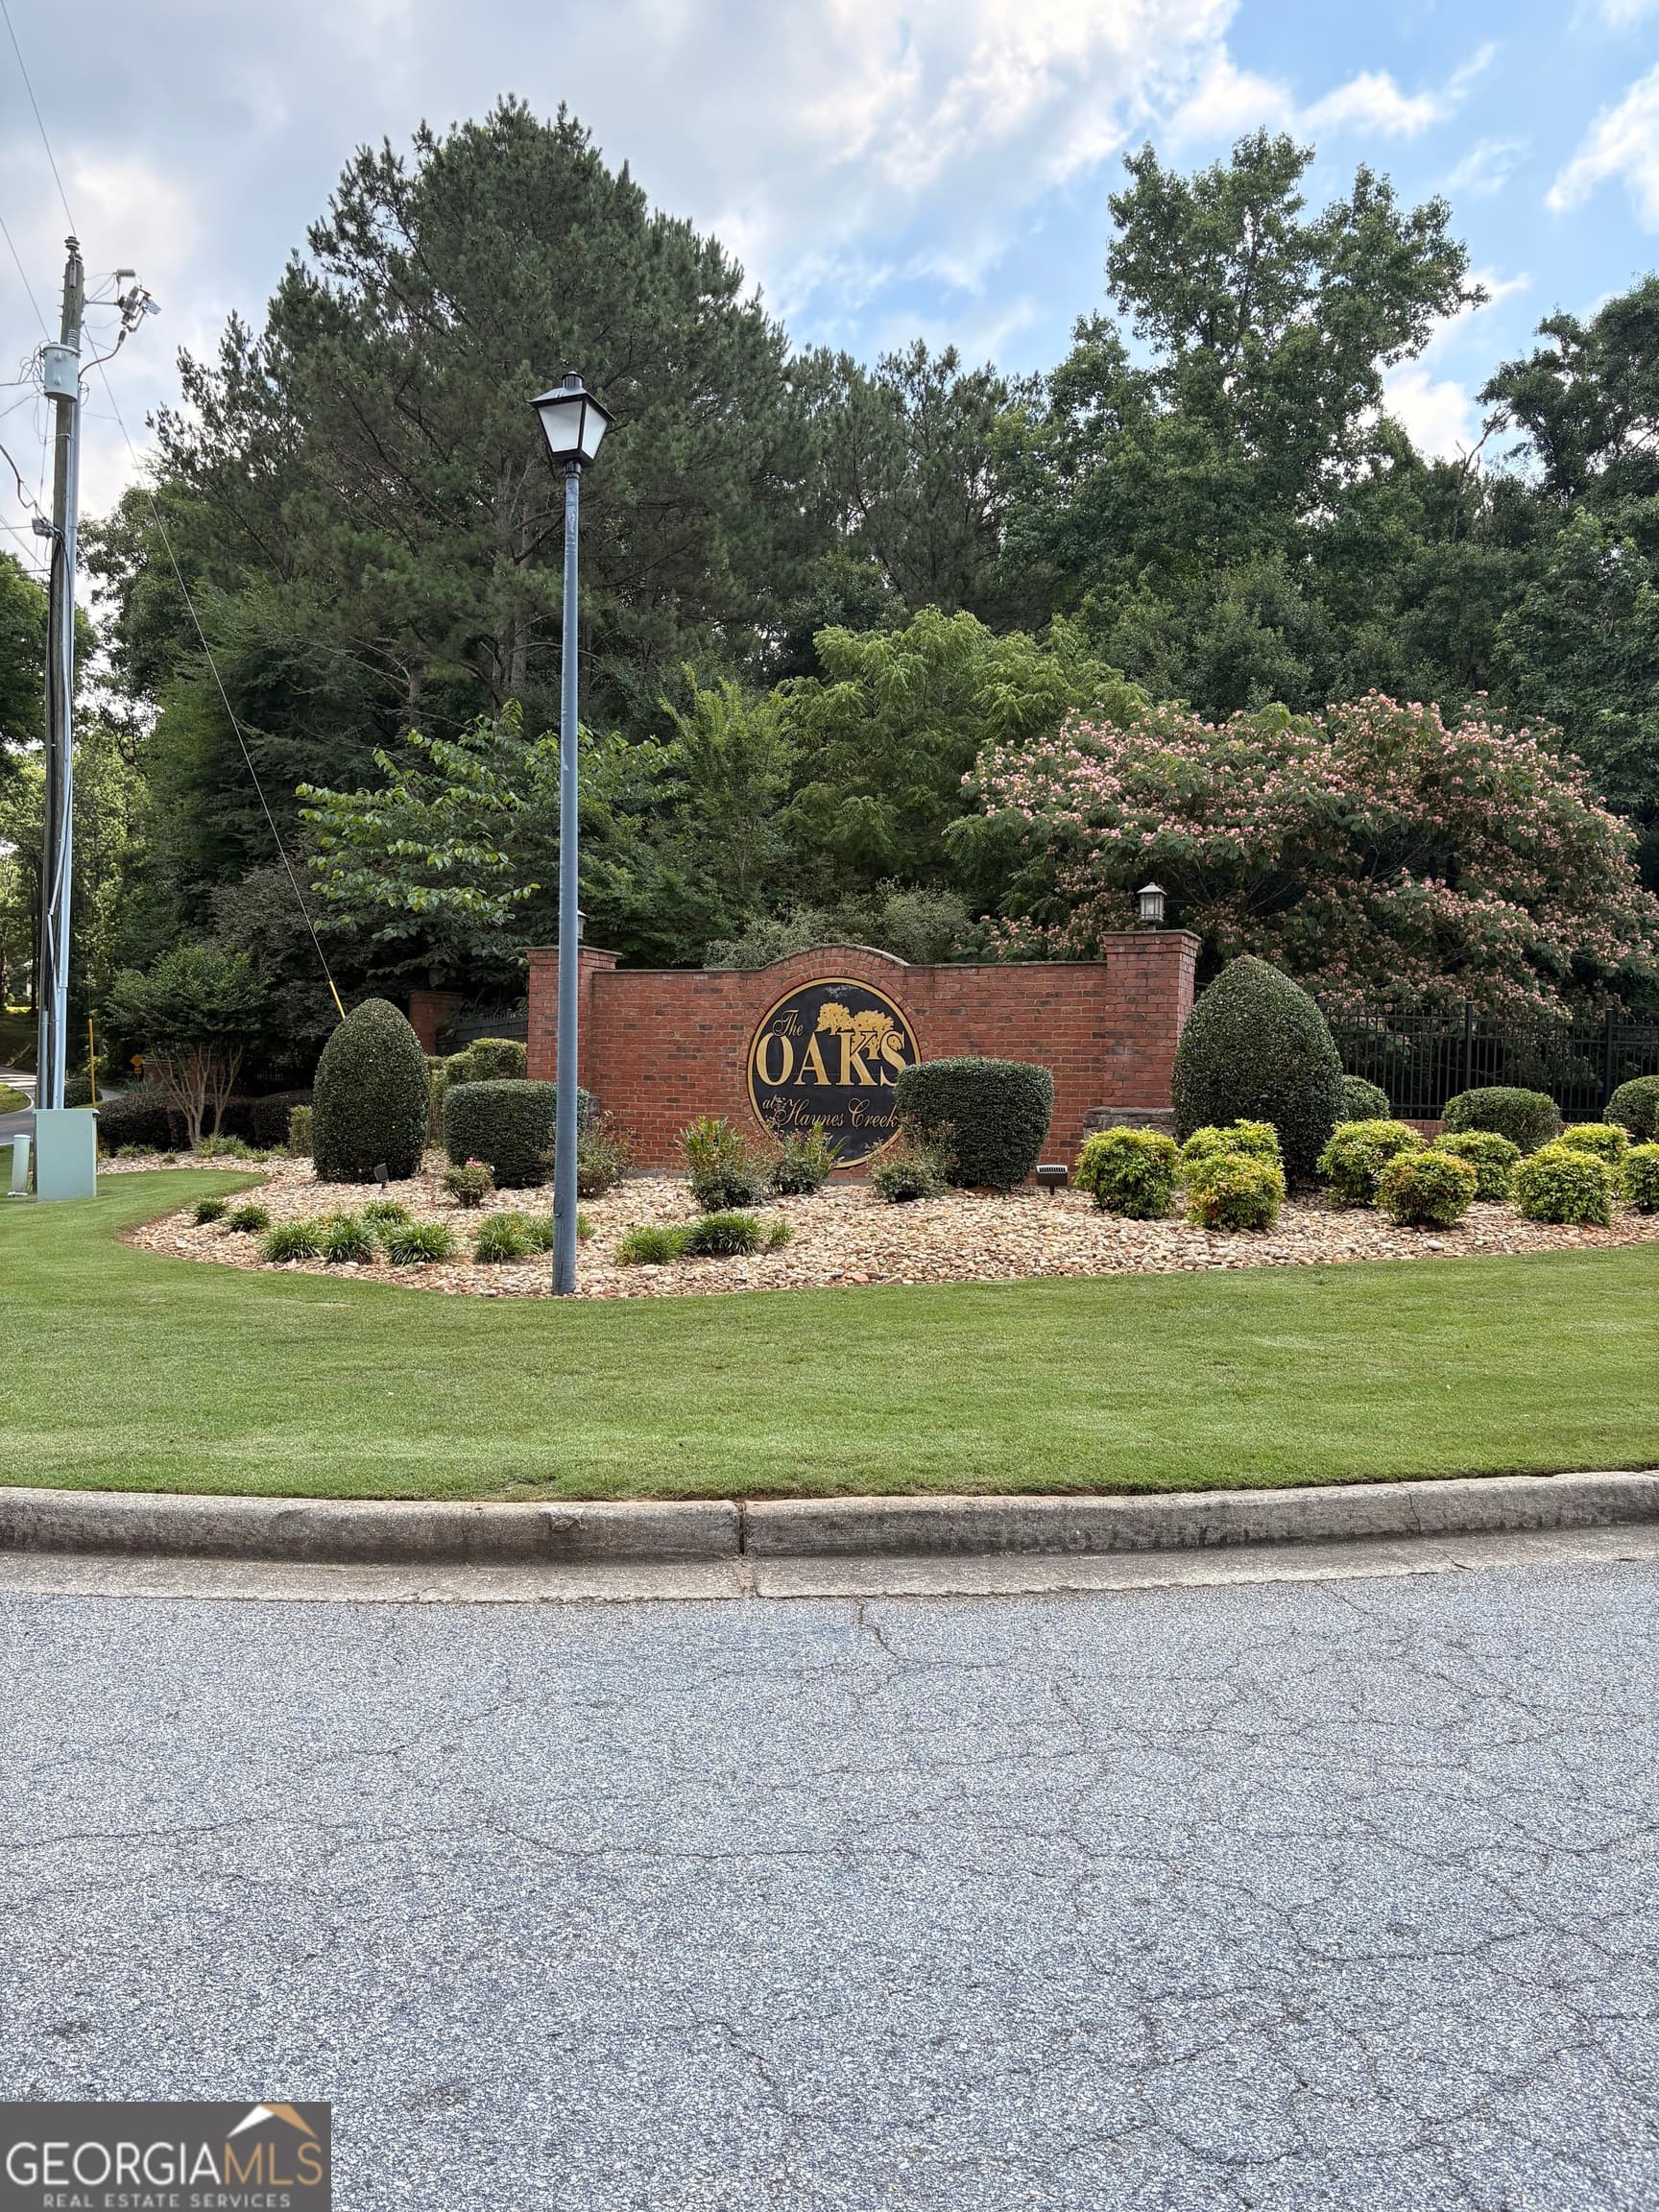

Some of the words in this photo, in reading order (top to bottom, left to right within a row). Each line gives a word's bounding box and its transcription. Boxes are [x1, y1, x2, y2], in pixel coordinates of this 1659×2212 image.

[772, 1009, 805, 1036] The
[756, 1030, 906, 1087] OAKS
[762, 1094, 778, 1110] at
[848, 1097, 899, 1129] Creek
